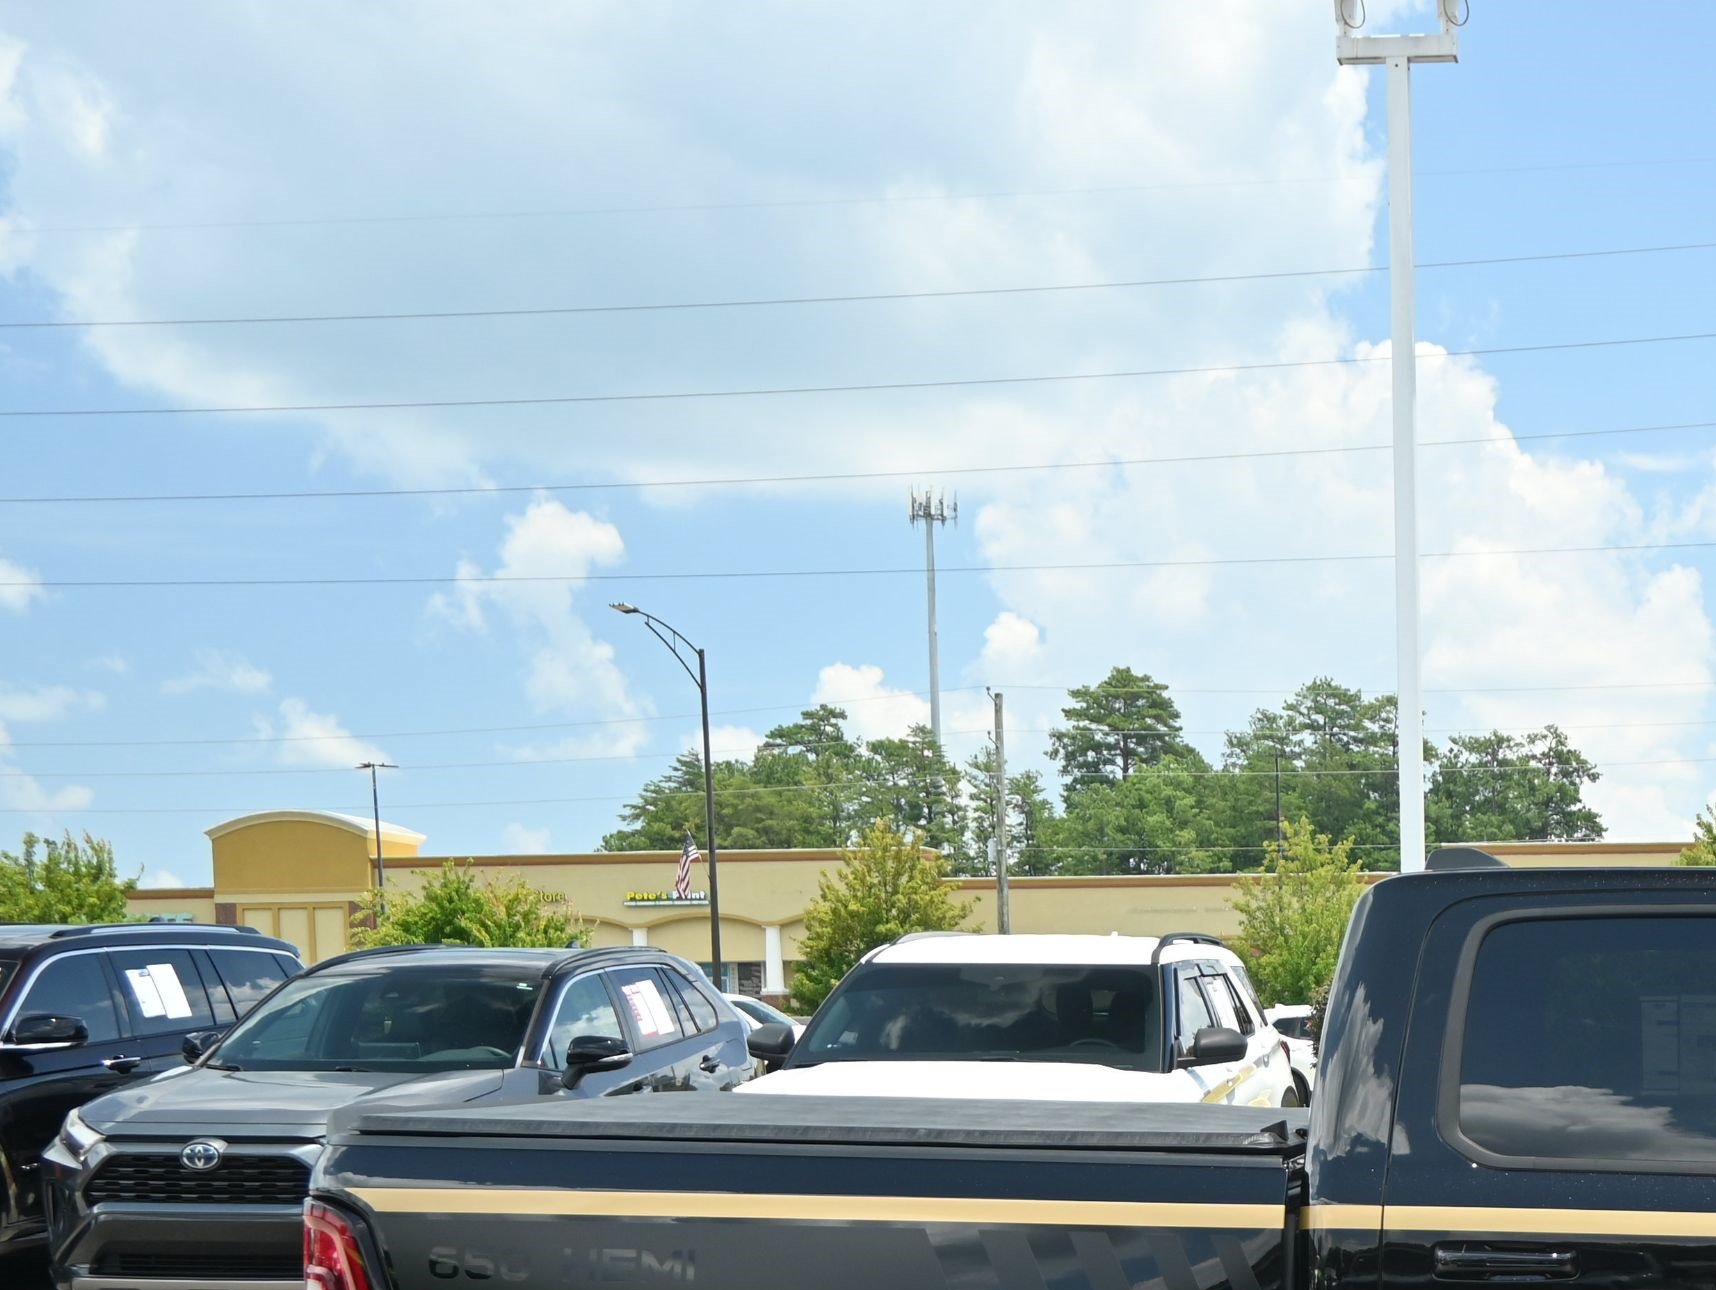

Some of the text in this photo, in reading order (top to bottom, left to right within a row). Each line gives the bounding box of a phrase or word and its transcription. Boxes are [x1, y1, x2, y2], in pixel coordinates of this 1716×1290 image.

[626, 890, 706, 901] Pete's Pint
[428, 1246, 696, 1282] 650 HEMI
